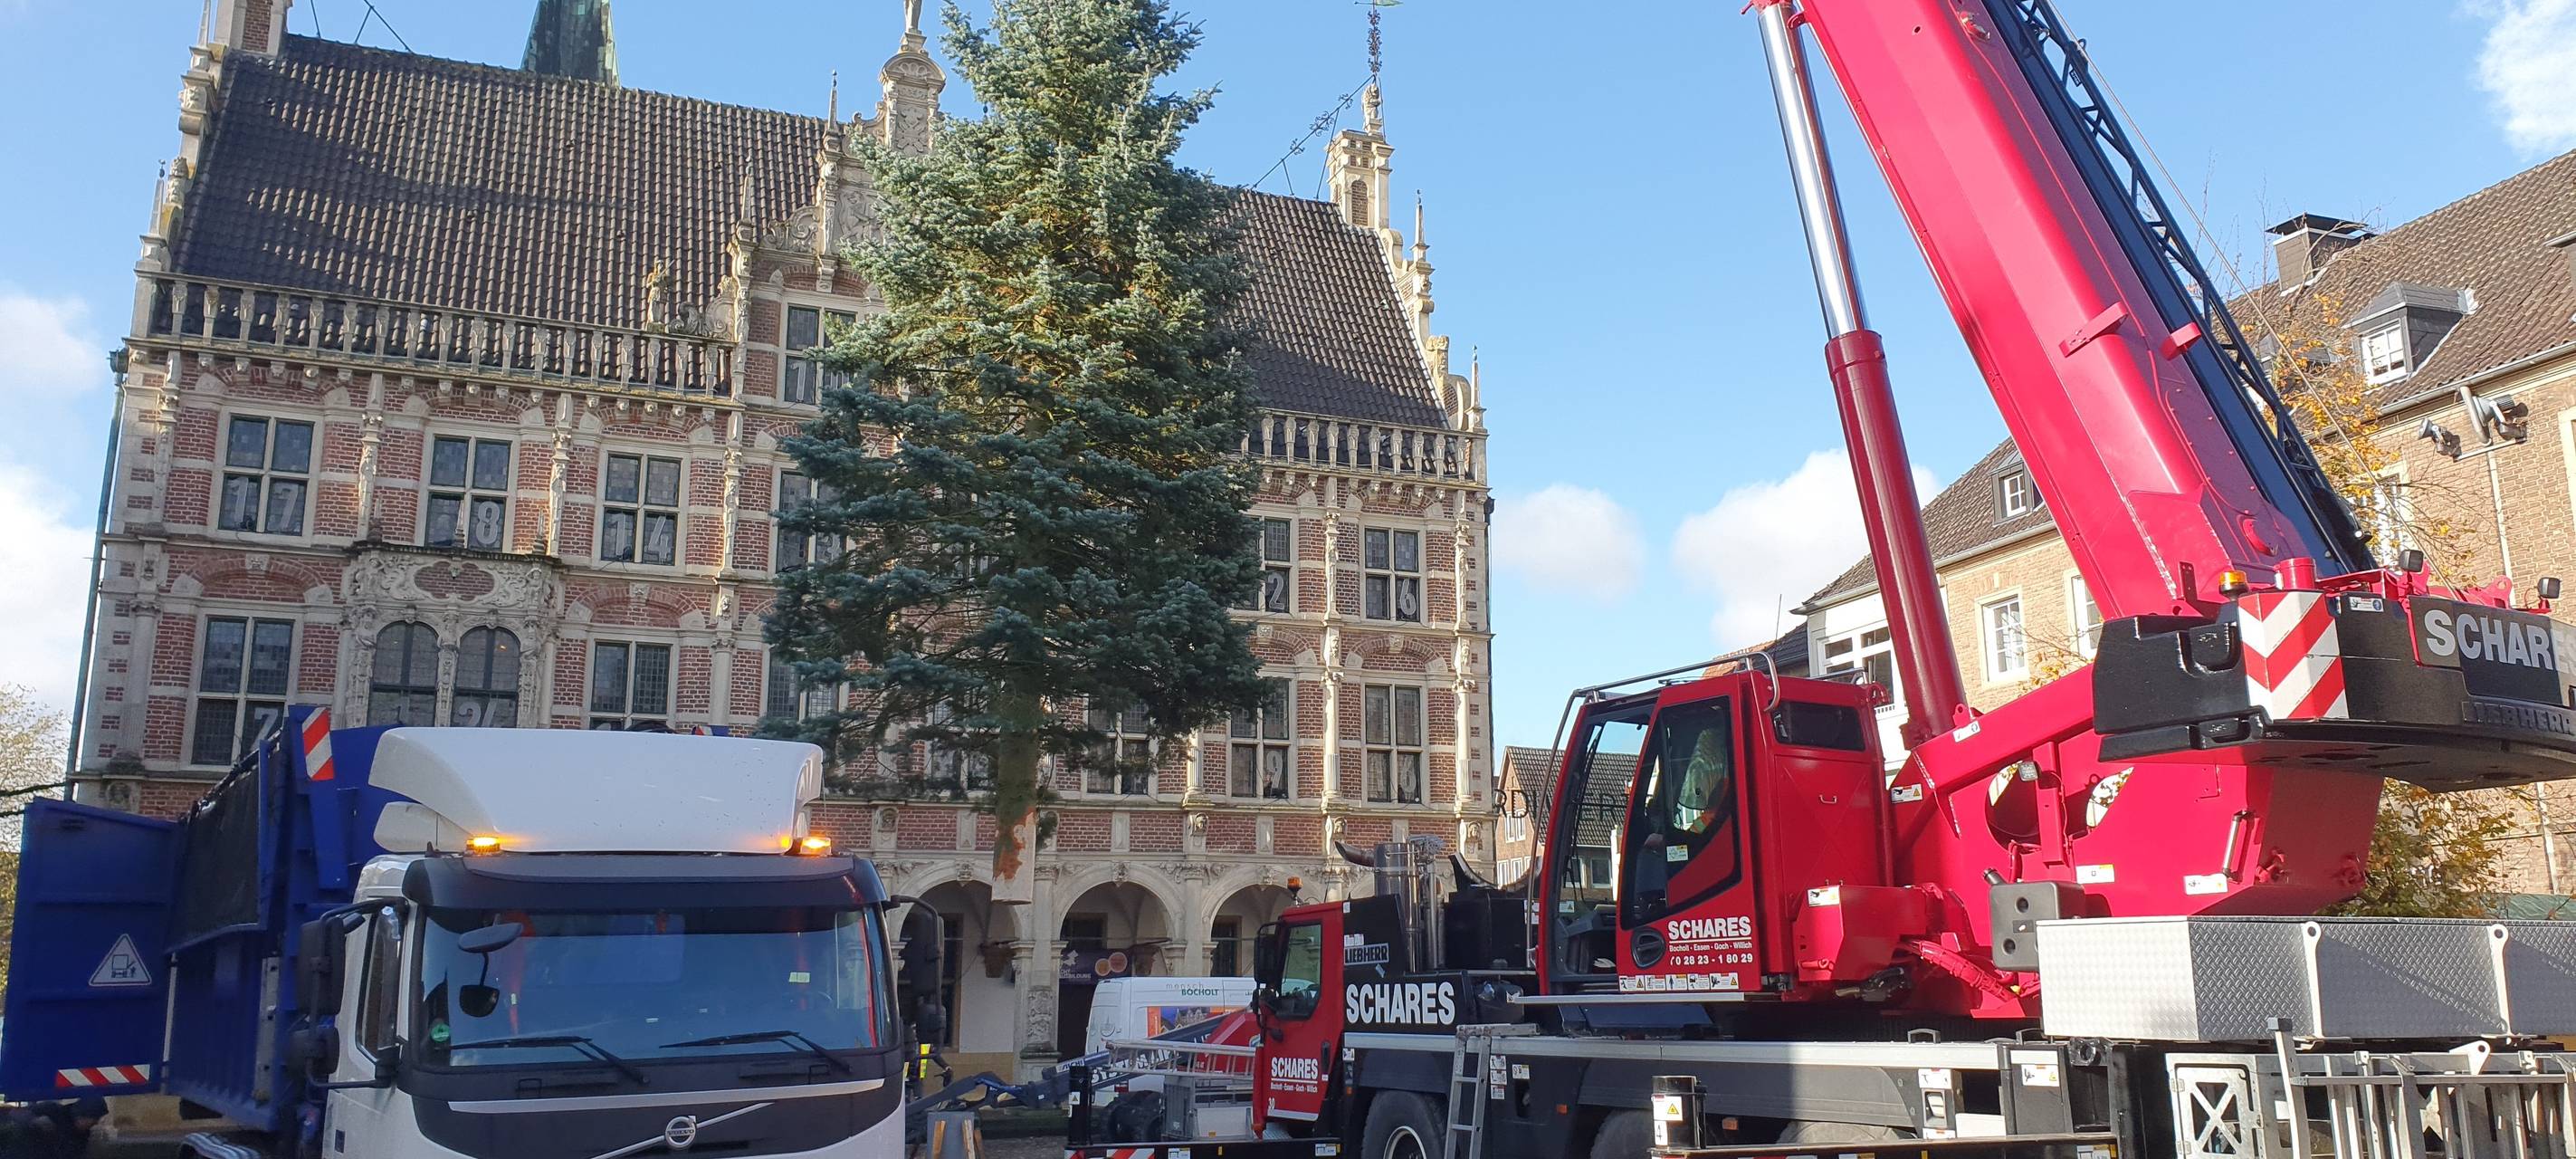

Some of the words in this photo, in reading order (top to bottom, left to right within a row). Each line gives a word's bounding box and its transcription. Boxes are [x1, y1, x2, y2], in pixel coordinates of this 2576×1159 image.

[475, 501, 500, 545] 8
[1399, 579, 1417, 616] 6
[2424, 609, 2576, 678] SCHARE
[1266, 750, 1283, 790] 9
[1668, 916, 1751, 940] SCHARES
[1344, 945, 1388, 963] LIEBHERR
[1684, 955, 1695, 965] 28
[1697, 955, 1709, 964] 23
[1718, 954, 1723, 964] 1
[1726, 953, 1738, 963] 80
[1741, 953, 1753, 963] 29
[1181, 988, 1219, 996] BOCHOLT
[1346, 982, 1455, 1025] SCHARES
[1271, 1057, 1318, 1079] SCHARES
